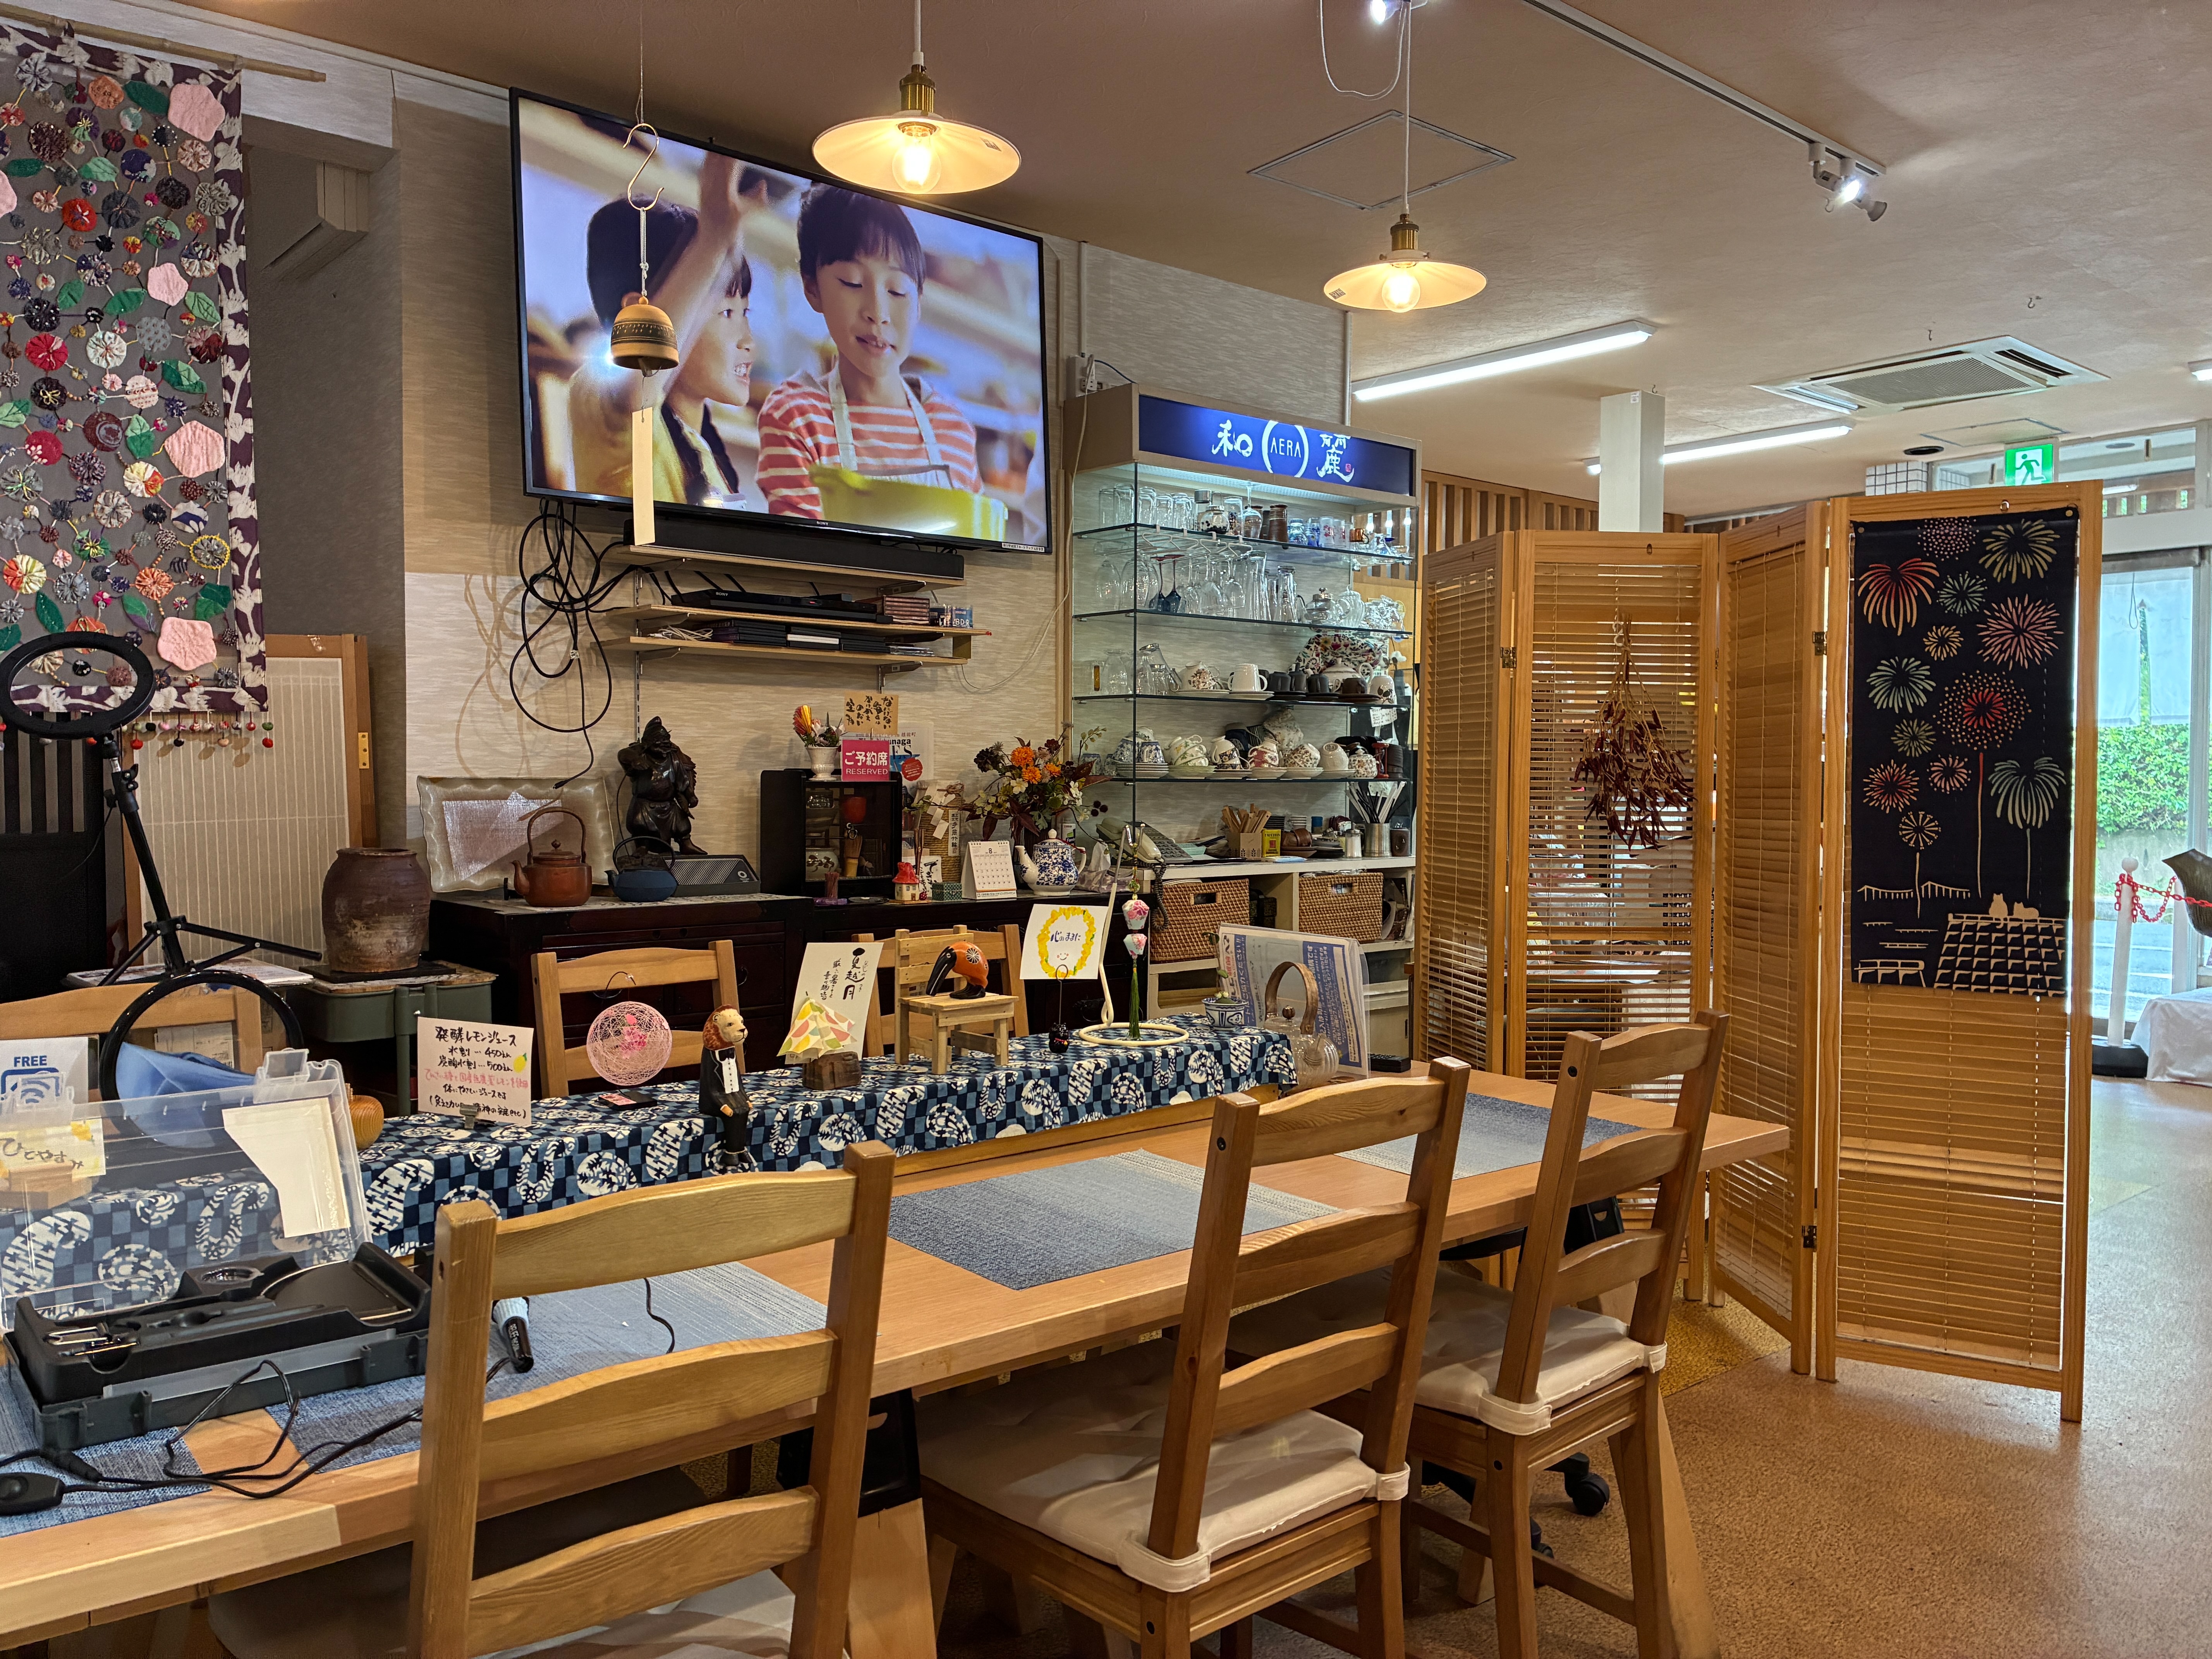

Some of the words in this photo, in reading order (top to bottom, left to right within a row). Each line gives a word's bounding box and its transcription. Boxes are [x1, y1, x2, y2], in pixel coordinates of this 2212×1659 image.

[1212, 419, 1253, 457] 和
[1270, 437, 1301, 458] AERA
[1316, 434, 1354, 483] 麗
[845, 750, 888, 766] ご予約席
[1050, 931, 1081, 942] 心のままに
[435, 1026, 517, 1047] 発酵レモンジュース
[448, 1046, 470, 1057] 水割
[485, 1047, 512, 1058] 450えん
[14, 1055, 47, 1067] FREE
[438, 1055, 476, 1070] 炭酸水割
[487, 1061, 513, 1072] 500えん
[443, 1084, 507, 1100] 体にやさしいジュースです
[0, 1137, 84, 1169] ひとやすみ
